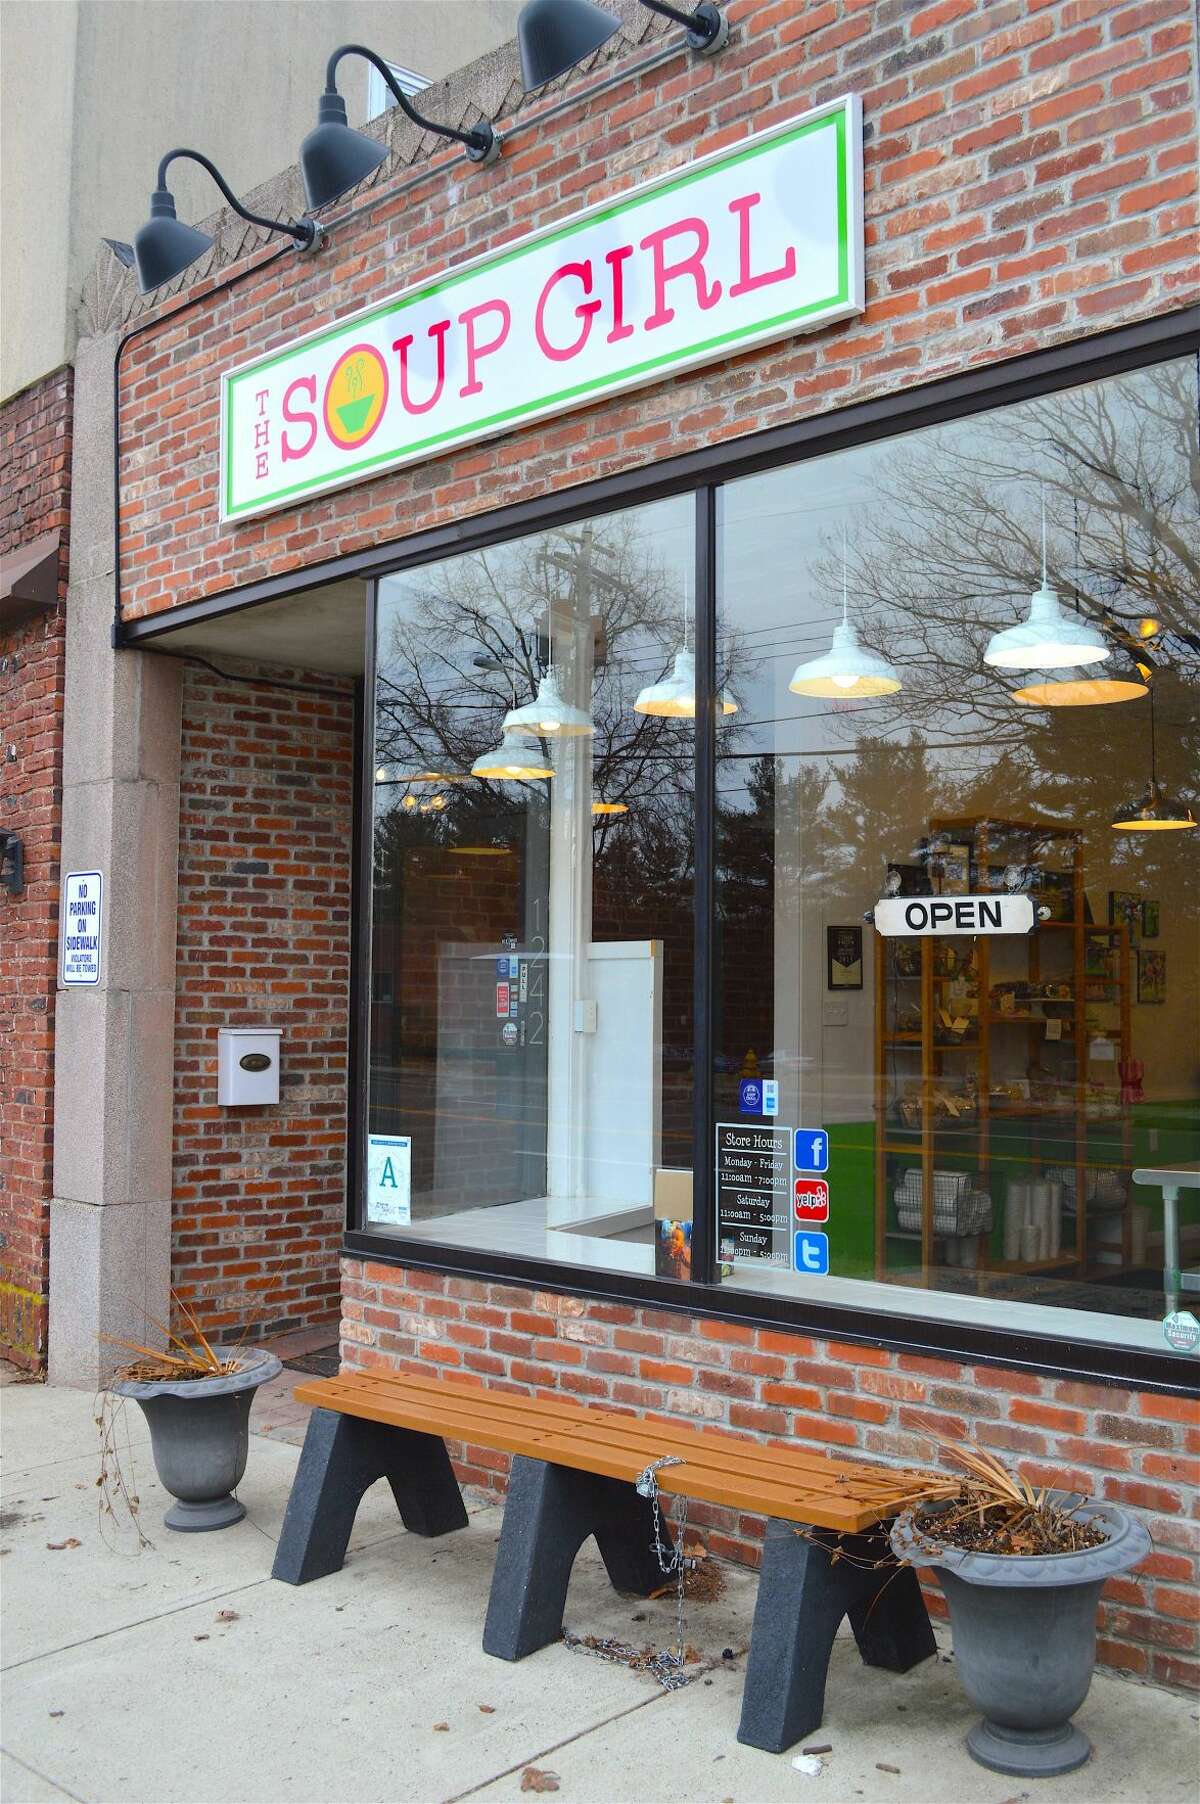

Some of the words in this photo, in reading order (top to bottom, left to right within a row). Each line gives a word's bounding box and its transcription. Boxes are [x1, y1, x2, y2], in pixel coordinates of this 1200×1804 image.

[280, 299, 511, 463] SOUP
[534, 192, 797, 362] GIRL
[254, 389, 270, 480] THE
[78, 884, 88, 898] NO
[69, 901, 96, 916] PARKING
[905, 901, 1002, 931] OPEN
[77, 919, 87, 933] ON
[66, 936, 98, 951] SIDEWALK
[76, 964, 82, 972] BE
[82, 964, 97, 973] TOWED
[529, 898, 545, 1045] 1242
[725, 1132, 751, 1147] Store
[753, 1134, 783, 1149] Hours
[724, 1156, 753, 1169] Monday
[759, 1158, 783, 1171] Friday
[379, 1156, 399, 1189] A
[721, 1173, 752, 1183] 11:00am
[758, 1176, 787, 1187] 7:00pm
[736, 1194, 770, 1208] Saturday
[796, 1191, 817, 1210] yelp
[720, 1209, 751, 1219] 11:00am
[759, 1213, 788, 1224] 5:00pm
[739, 1231, 768, 1246] Sunday
